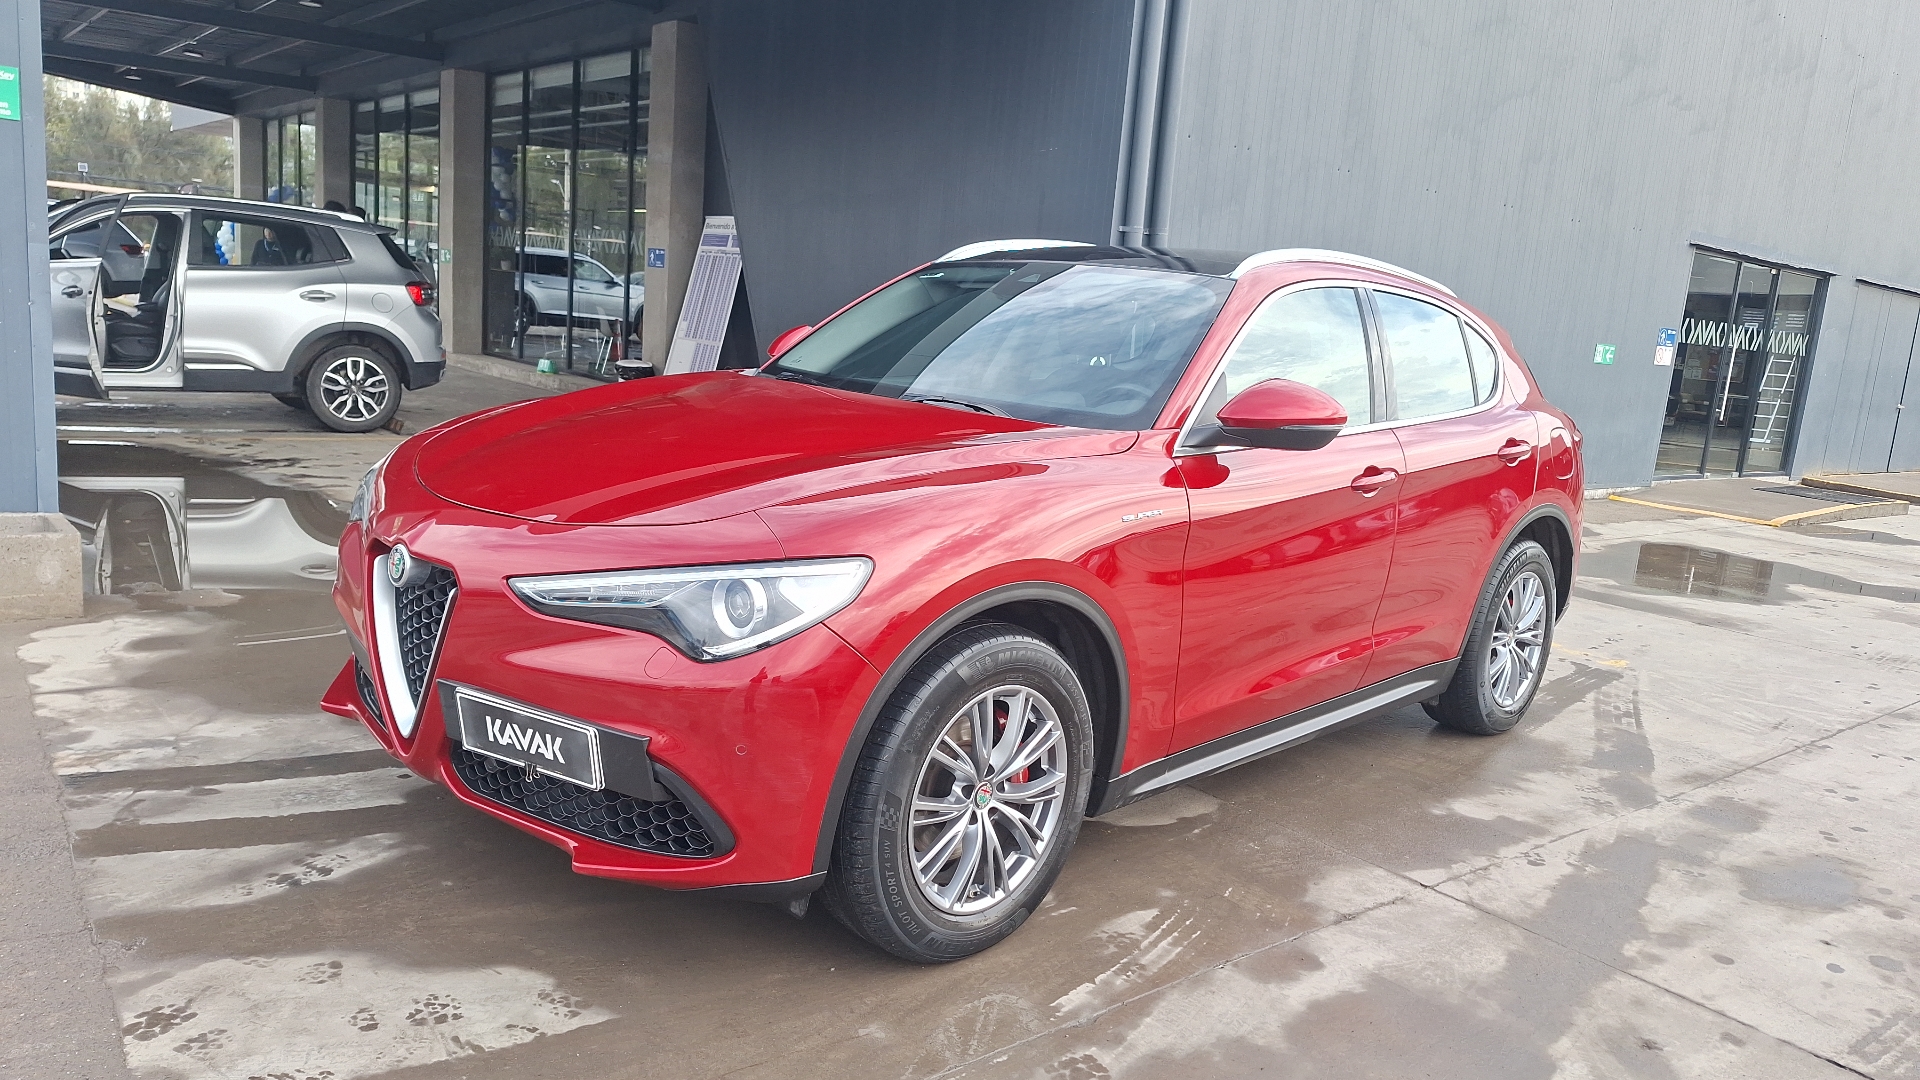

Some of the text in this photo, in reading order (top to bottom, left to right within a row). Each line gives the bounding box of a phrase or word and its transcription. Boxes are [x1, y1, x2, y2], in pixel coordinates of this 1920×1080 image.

[998, 650, 1064, 678] MICHELIN
[485, 715, 566, 765] KAVAK
[885, 870, 903, 909] SPORT
[897, 911, 922, 936] PILOT
